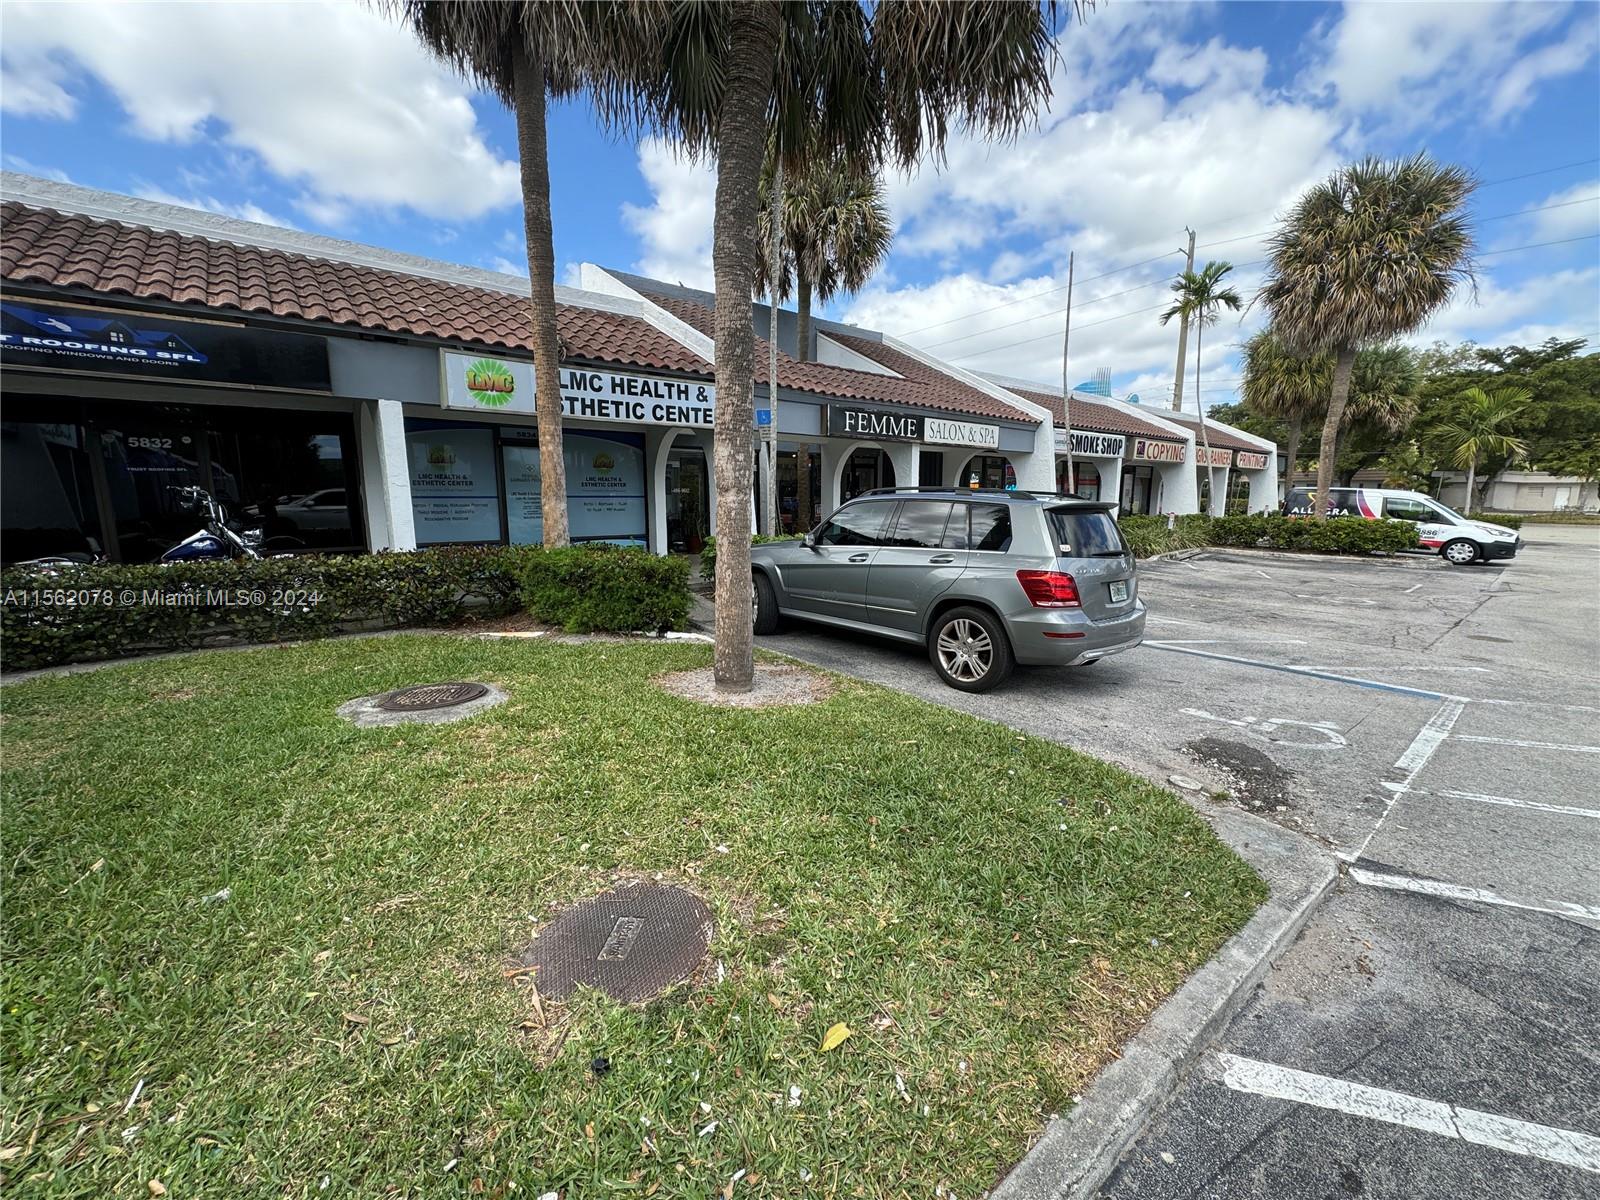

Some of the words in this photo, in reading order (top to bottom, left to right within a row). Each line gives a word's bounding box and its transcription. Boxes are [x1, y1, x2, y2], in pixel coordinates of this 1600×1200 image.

[22, 336, 147, 356] ROOFING
[156, 351, 201, 362] SFL
[56, 349, 118, 361] WINDOWS
[121, 355, 139, 363] AND
[142, 358, 179, 366] DOORS
[466, 370, 514, 393] LMC
[559, 370, 603, 392] LMC
[611, 376, 689, 401] HEALTH
[696, 386, 708, 403] &
[652, 404, 713, 424] CENTE
[844, 411, 917, 438] FEMME
[128, 437, 172, 449] 5832
[929, 420, 966, 442] SALON
[968, 426, 977, 443] &
[979, 427, 995, 445] SPA
[1069, 434, 1100, 454] SMOKE
[1100, 437, 1123, 456] SHOP
[1147, 442, 1185, 461] COPYING
[1239, 453, 1264, 469] PRINTING
[1291, 506, 1349, 516] ALLGRA
